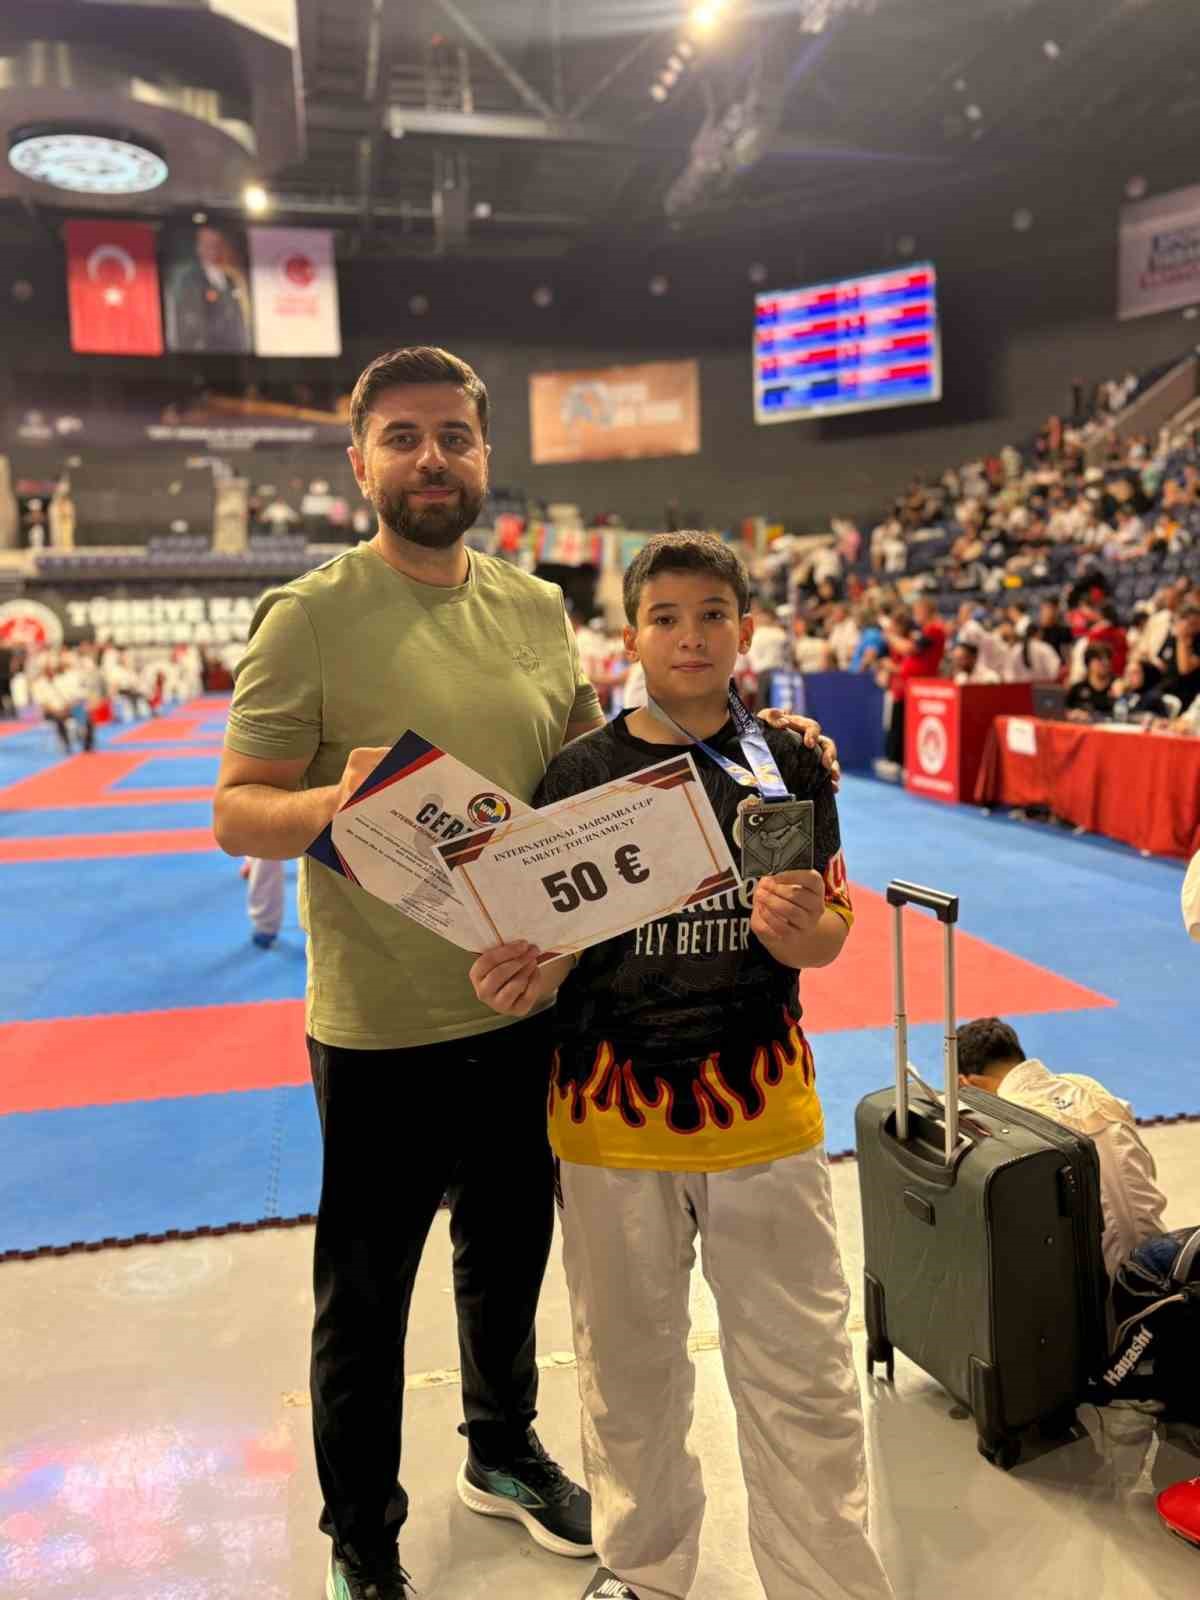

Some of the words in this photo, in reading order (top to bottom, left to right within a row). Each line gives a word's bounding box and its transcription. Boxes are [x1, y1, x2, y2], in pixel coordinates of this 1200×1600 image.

[416, 803, 472, 839] CER
[494, 827, 578, 862] INTERNATIONAL
[578, 807, 631, 833] MARMARA
[631, 797, 653, 814] CUP
[522, 846, 562, 866] KARATE
[566, 817, 636, 851] TOURNAMENT
[541, 861, 608, 913] 50
[614, 844, 650, 884] €
[635, 924, 668, 955] FLY
[677, 917, 751, 955] BETTER
[1103, 1323, 1153, 1386] Hayashi
